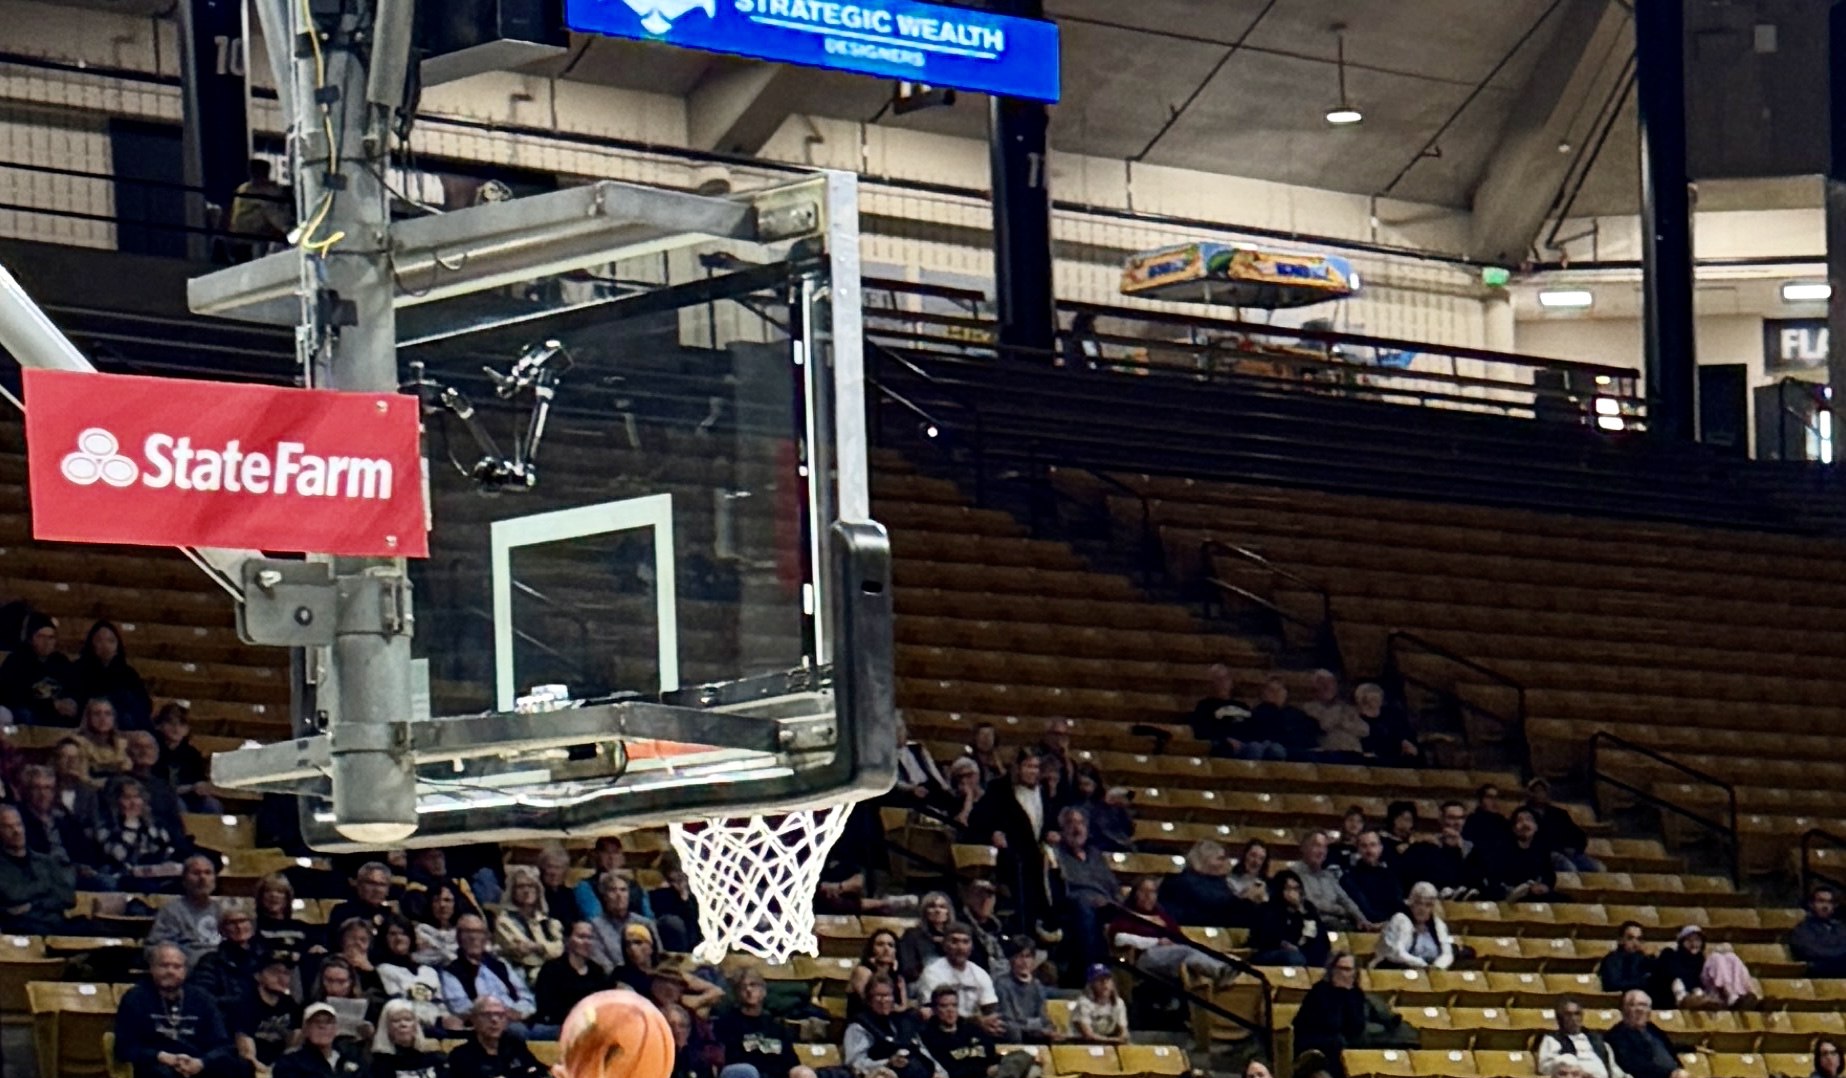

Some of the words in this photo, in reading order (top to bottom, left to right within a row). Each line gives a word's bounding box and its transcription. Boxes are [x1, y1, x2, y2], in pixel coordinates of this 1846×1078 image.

[734, 0, 892, 33] STRATEGIC
[896, 13, 1005, 52] WEALTH
[823, 37, 926, 67] DESIGNERS
